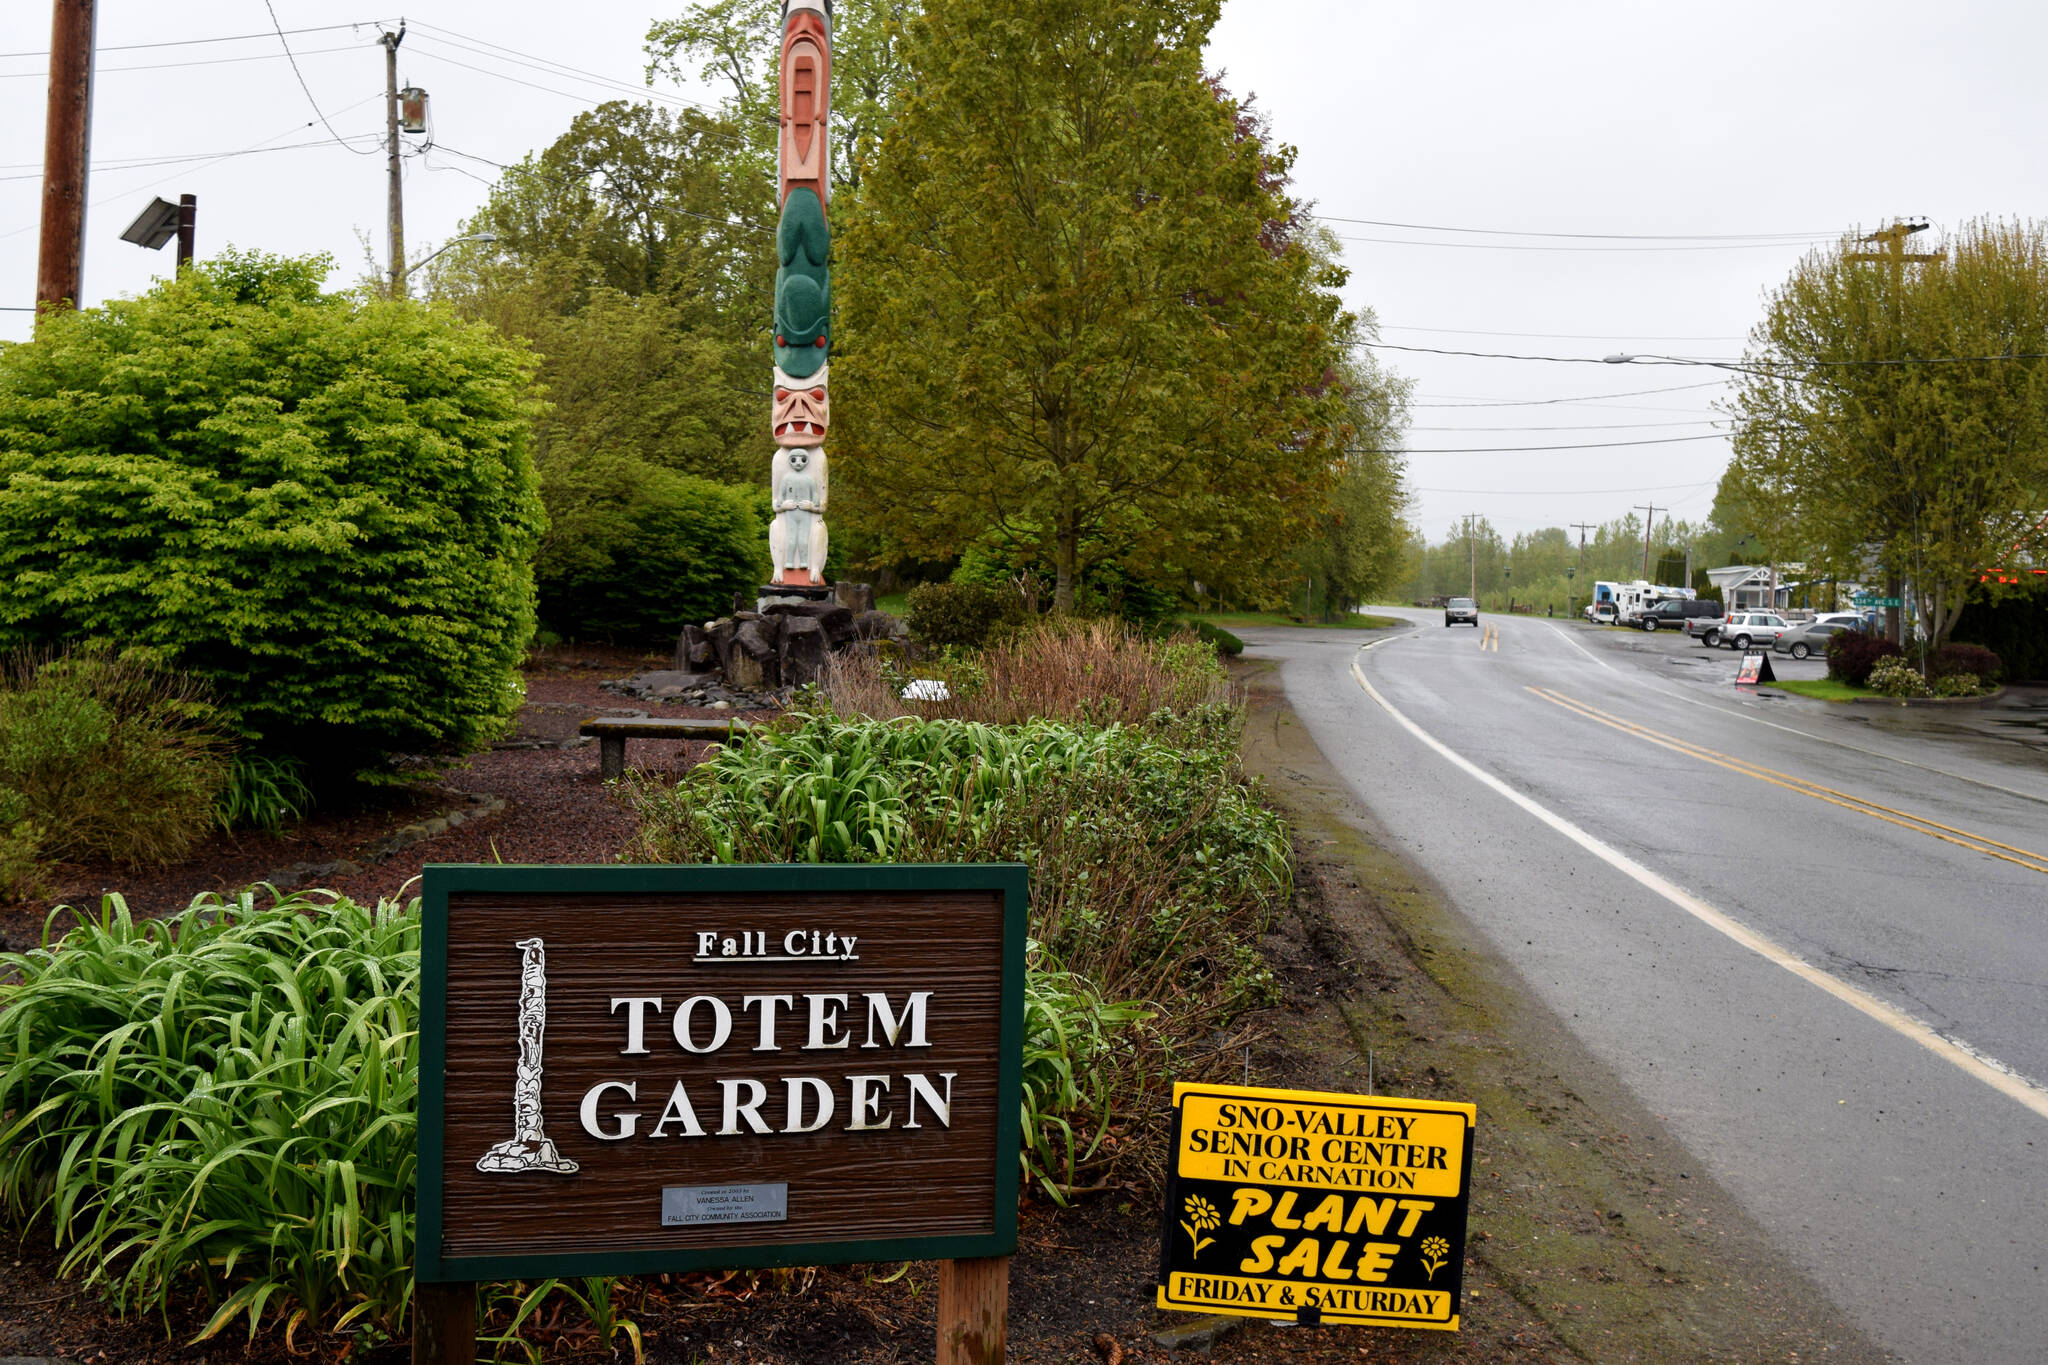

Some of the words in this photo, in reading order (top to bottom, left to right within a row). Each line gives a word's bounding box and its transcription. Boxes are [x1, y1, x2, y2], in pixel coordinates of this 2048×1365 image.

[697, 931, 766, 957] Fall
[784, 929, 858, 960] City
[610, 991, 934, 1054] TOTEM
[579, 1072, 958, 1141] GARDEN
[1217, 1104, 1417, 1140] SNO-VALLEY
[1188, 1129, 1310, 1160] SENIOR
[1322, 1139, 1448, 1170] CENTER
[1223, 1159, 1249, 1177] IN
[1259, 1162, 1416, 1190] CARNATION
[685, 1214, 699, 1222] CITY
[701, 1213, 739, 1221] COMMUNITY
[740, 1211, 782, 1219] ASSOCIATION
[696, 1196, 730, 1204] VANESSA
[731, 1195, 754, 1203] ALLEN
[1228, 1188, 1435, 1238] PLANT
[1240, 1235, 1401, 1283] SALE
[1178, 1277, 1272, 1304] FRIDAY
[1279, 1286, 1295, 1306] &
[1305, 1288, 1440, 1315] SATURDAY
